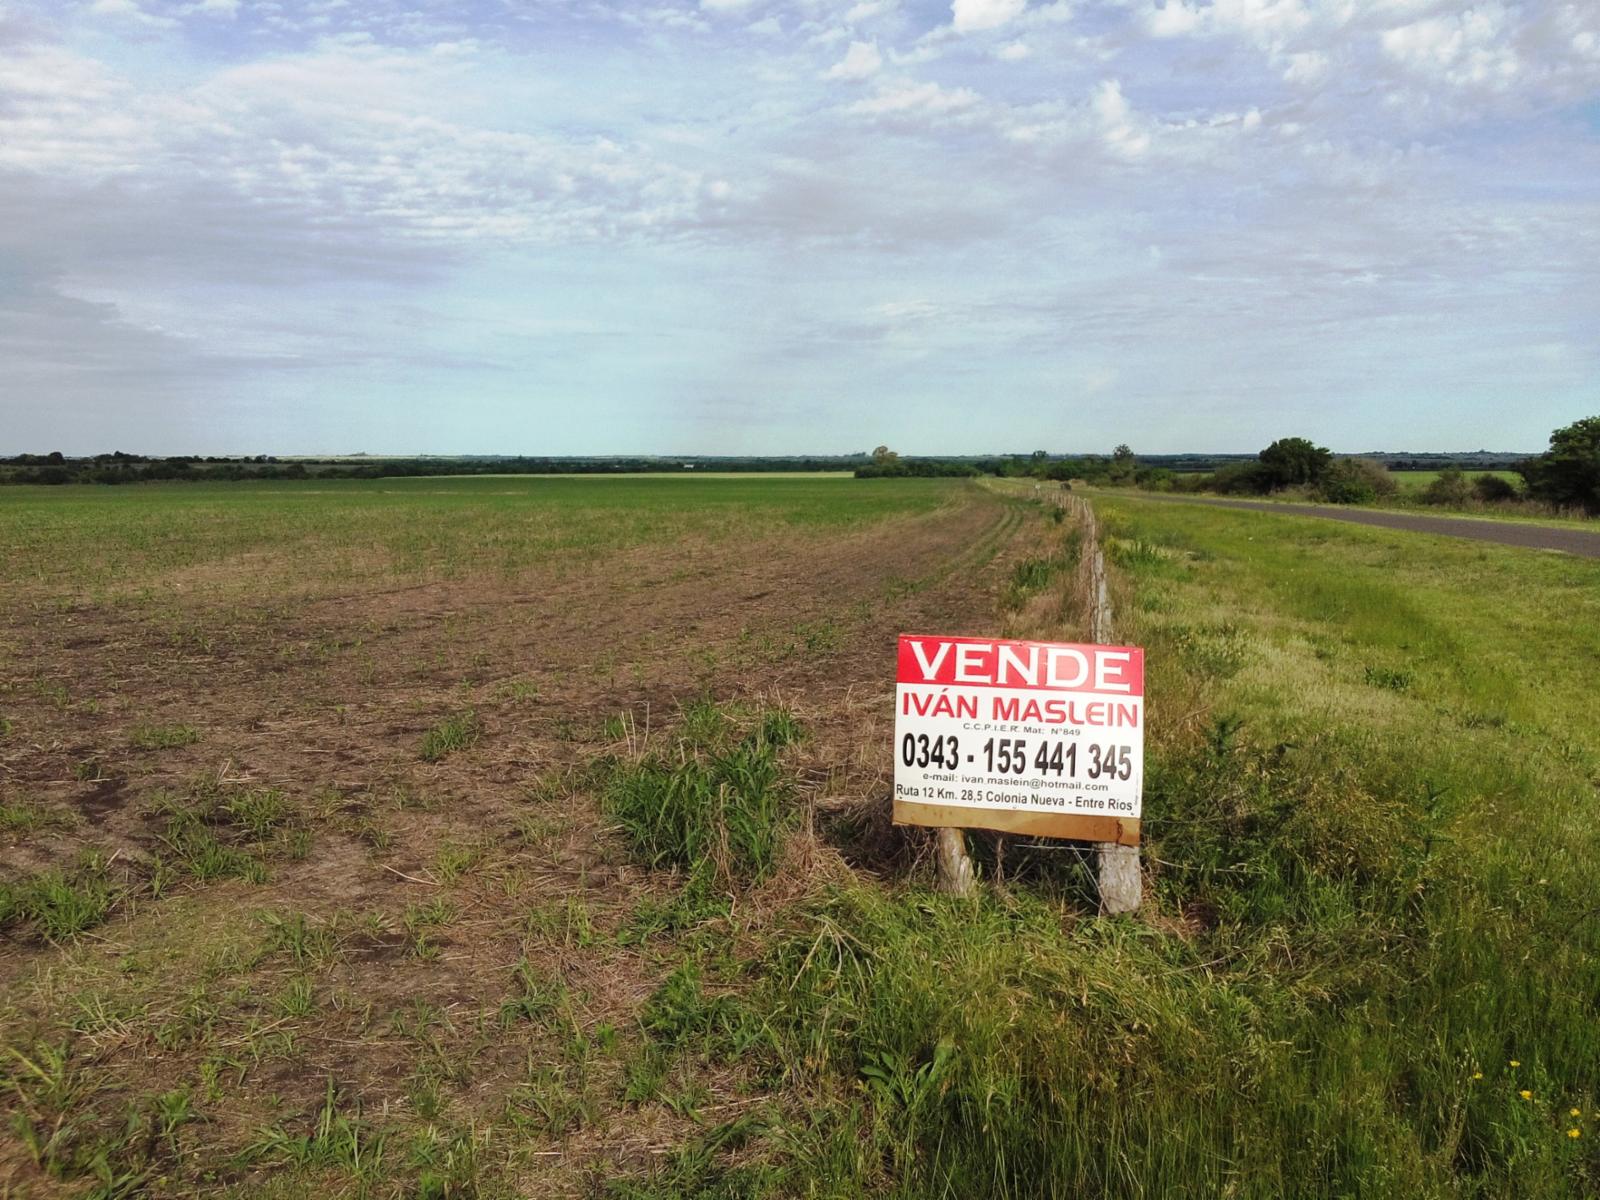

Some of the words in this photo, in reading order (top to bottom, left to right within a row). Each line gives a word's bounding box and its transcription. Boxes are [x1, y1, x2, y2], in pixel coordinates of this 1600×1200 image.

[909, 641, 1131, 693] VENDE
[903, 688, 978, 719] IVÁN
[993, 697, 1138, 728] MASLEIN
[902, 733, 959, 770] 0343
[984, 737, 1027, 774] 155
[1034, 740, 1077, 777] 441
[1088, 743, 1132, 781] 345
[896, 783, 919, 796] Ruta
[923, 787, 934, 798] 12
[937, 788, 958, 800] Km.
[986, 791, 1027, 805] Colonia
[1031, 794, 1065, 807] Nueva
[1075, 796, 1105, 809] Entre
